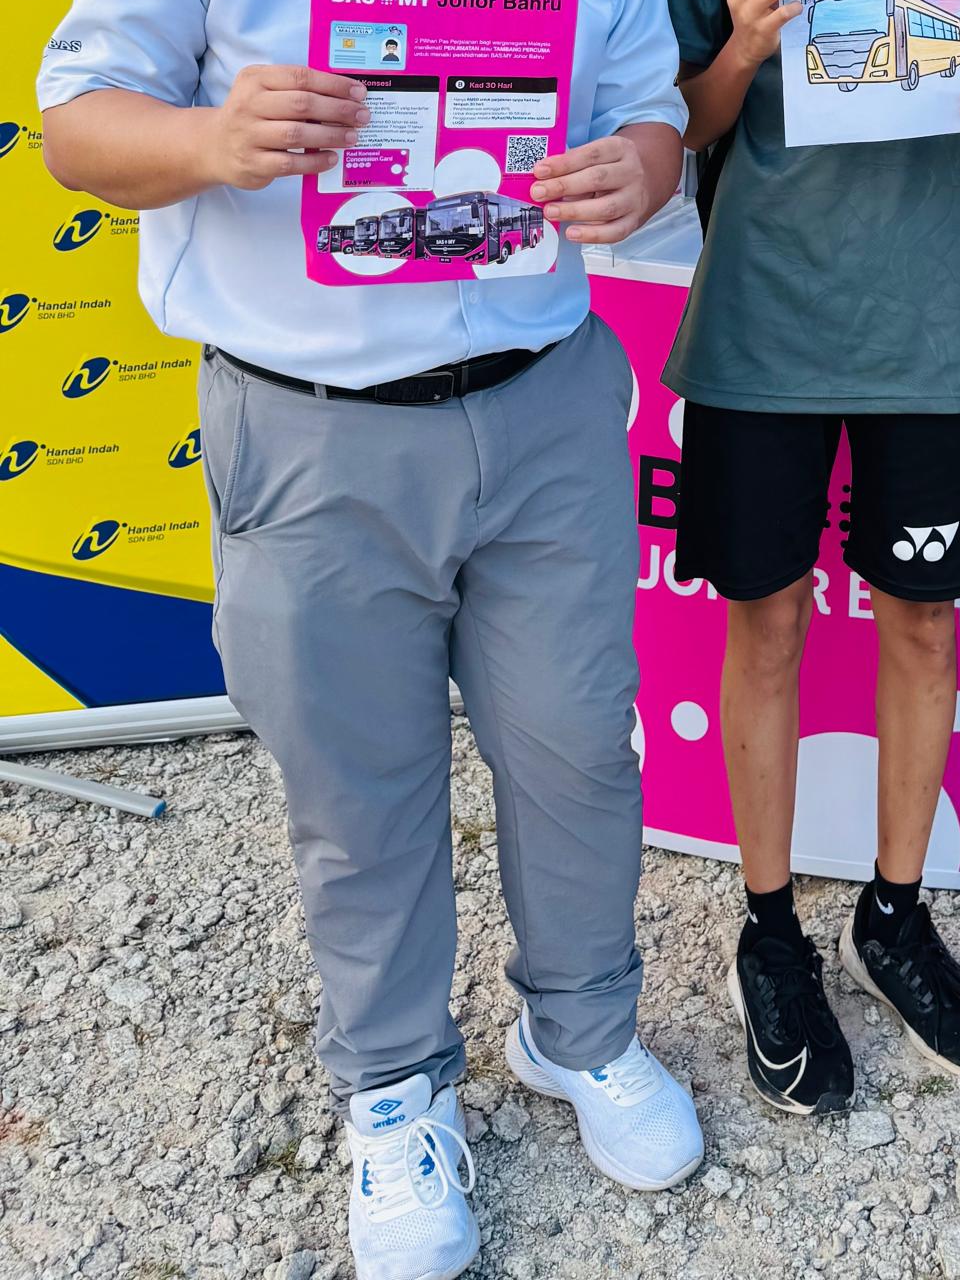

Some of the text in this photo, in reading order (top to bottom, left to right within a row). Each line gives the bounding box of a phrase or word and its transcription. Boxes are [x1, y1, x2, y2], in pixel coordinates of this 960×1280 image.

[38, 299, 112, 311] Handal Indah
[38, 311, 76, 320] SDN BHD
[118, 358, 192, 374] Handal Indah
[118, 372, 156, 382] SDN BHD
[46, 444, 120, 457] Handal Indah
[46, 456, 84, 466] SDN BHD
[127, 520, 200, 536] Handal Indah
[128, 534, 165, 544] SDN BHD
[372, 1114, 406, 1129] umbro
